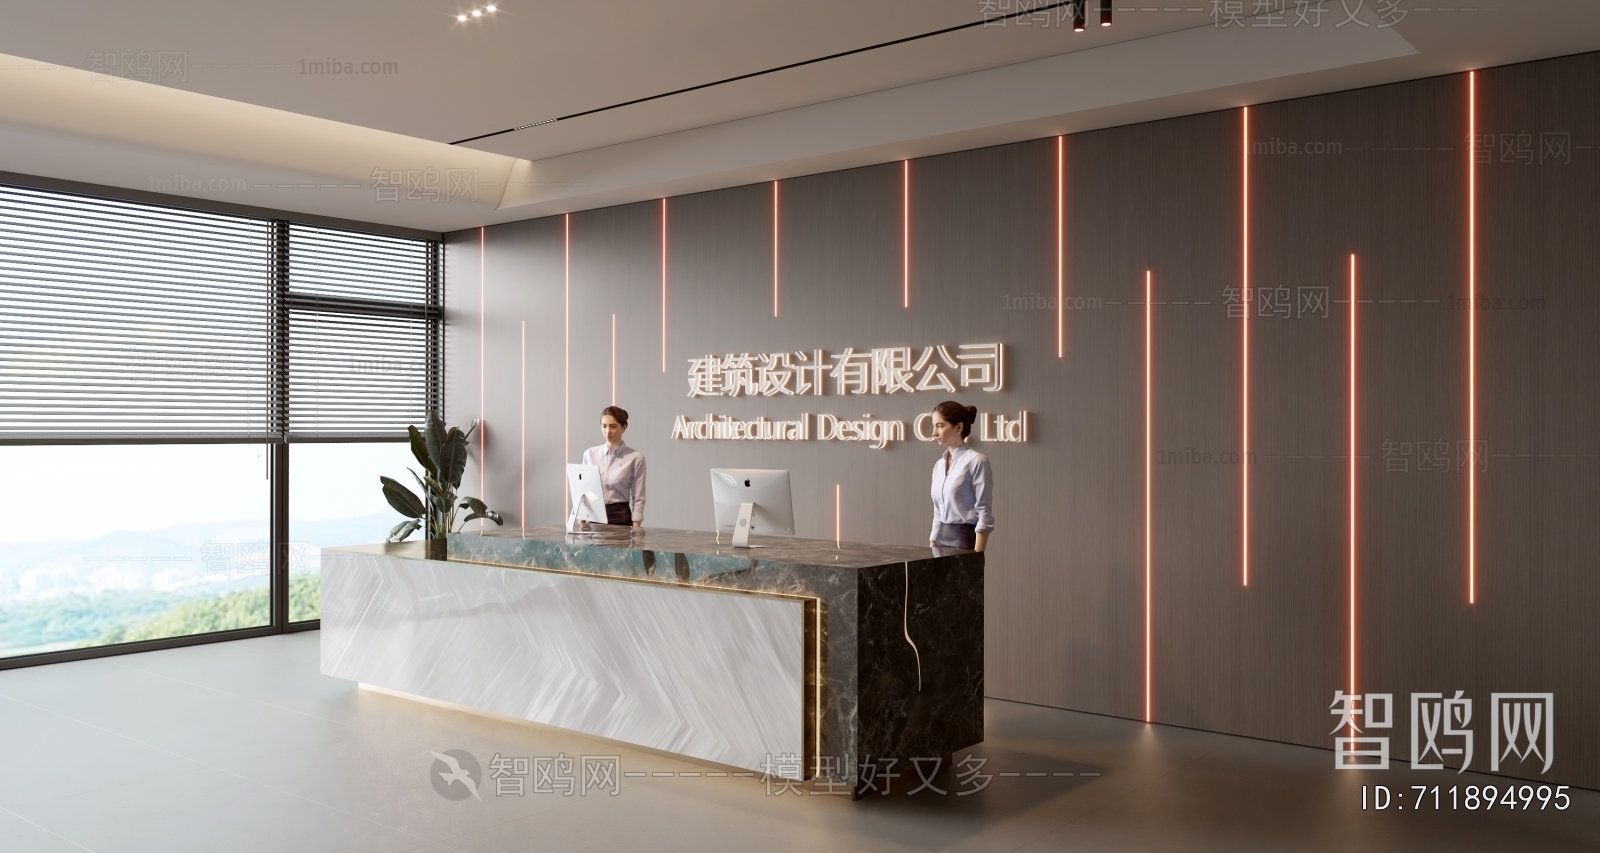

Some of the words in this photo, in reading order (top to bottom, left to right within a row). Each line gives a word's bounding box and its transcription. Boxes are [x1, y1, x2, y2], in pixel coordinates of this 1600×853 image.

[687, 342, 1005, 398] 建筑设计有限公司
[671, 412, 809, 441] Architectural
[816, 412, 905, 450] Design
[980, 410, 1028, 442] Ltd
